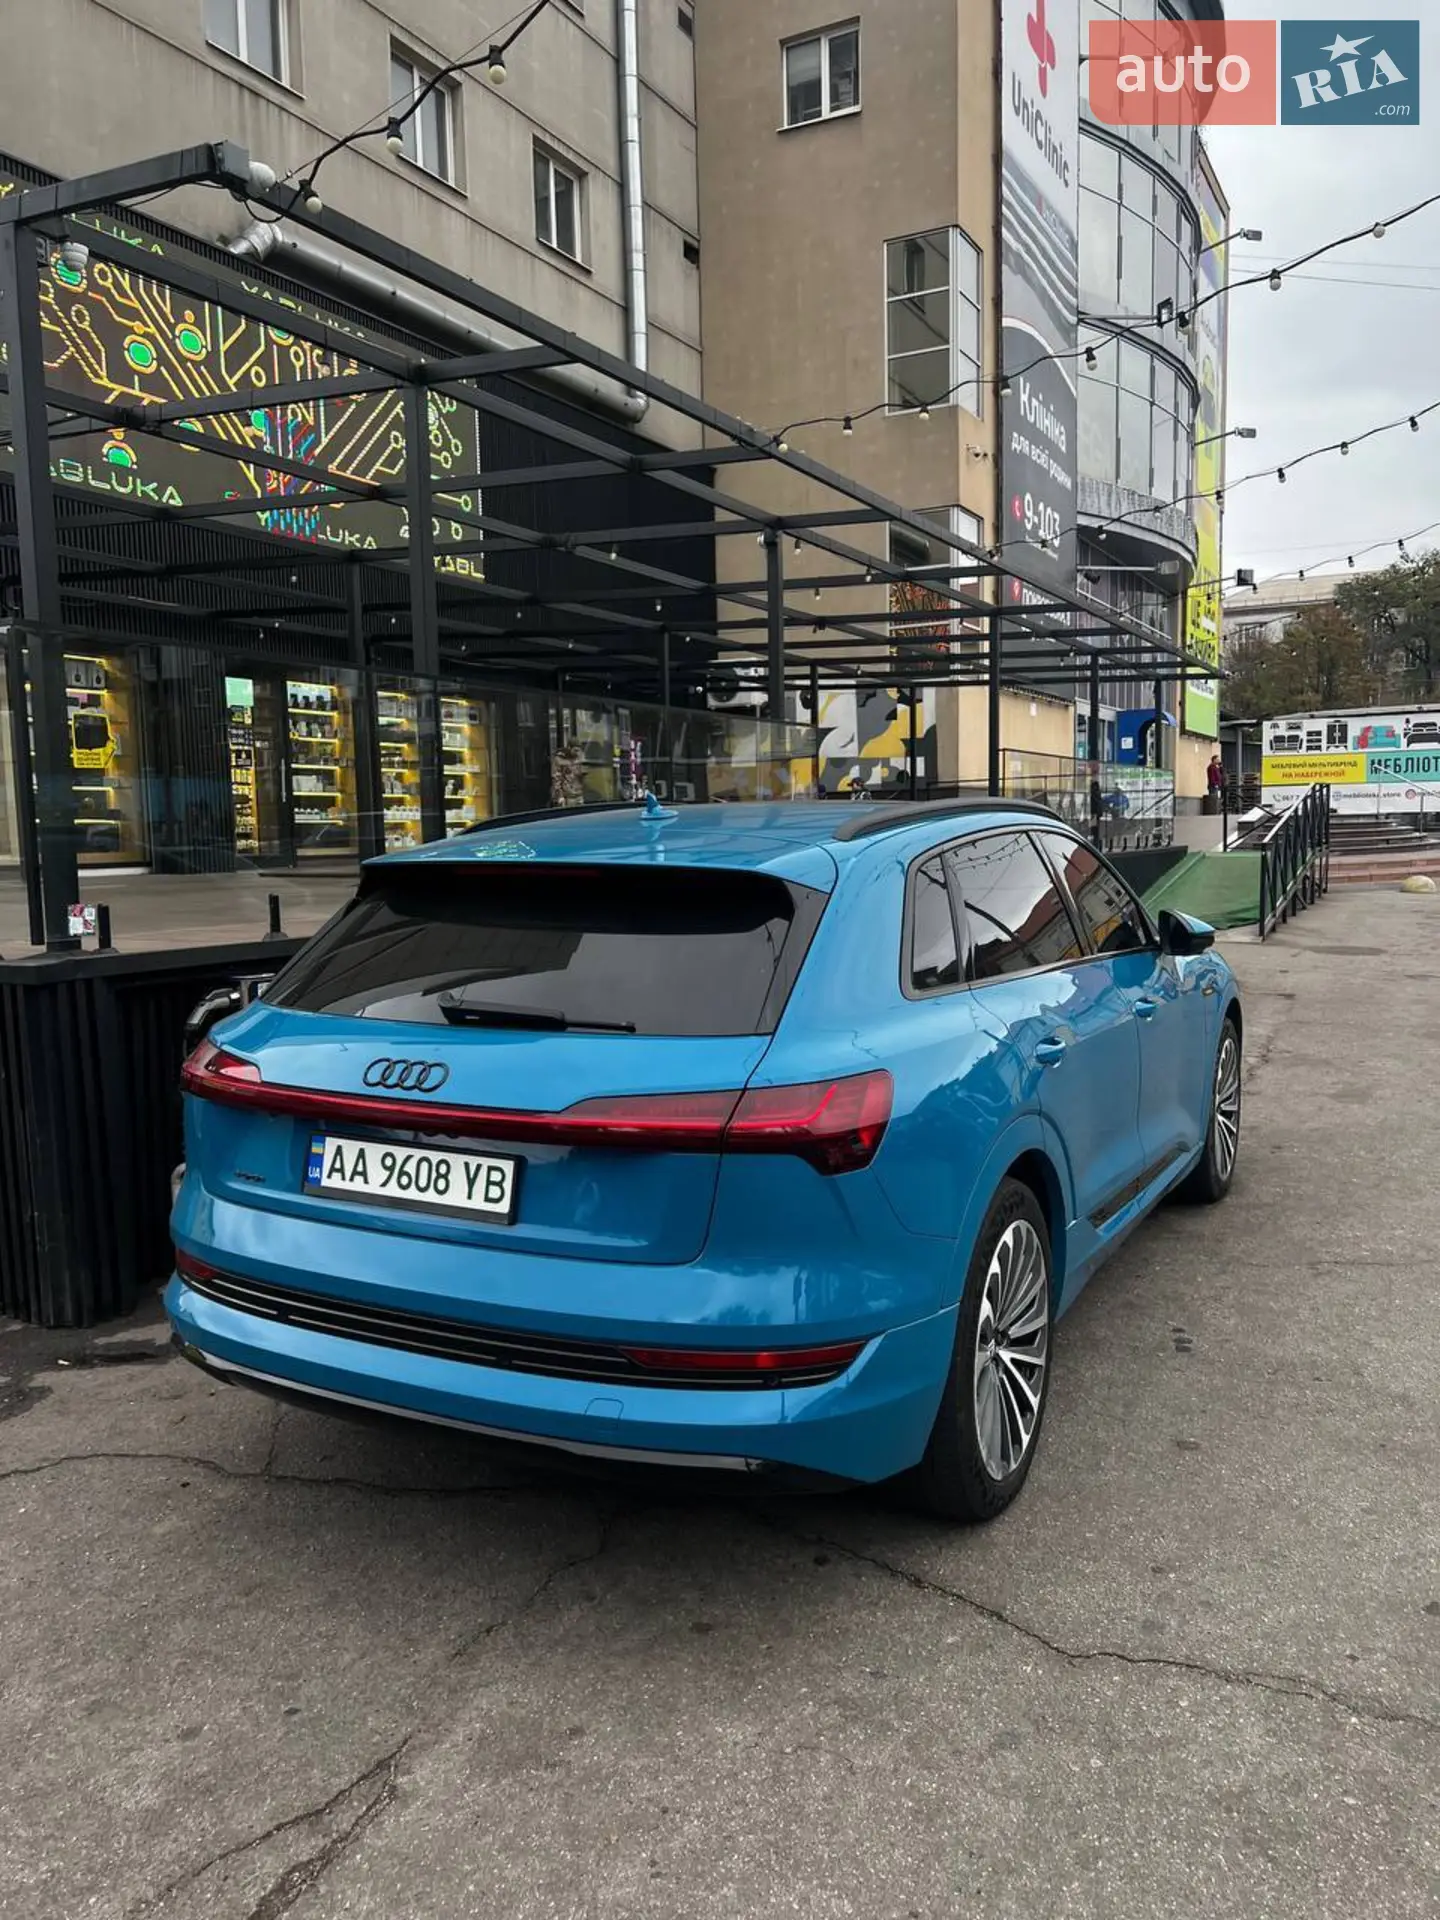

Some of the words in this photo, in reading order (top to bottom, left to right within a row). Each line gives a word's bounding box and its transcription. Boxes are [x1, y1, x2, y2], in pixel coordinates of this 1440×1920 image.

[1012, 72, 1069, 188] UniClinic
[1020, 376, 1067, 454] Клініка
[1024, 492, 1060, 548] 9-103
[308, 1166, 321, 1179] UA
[327, 1144, 369, 1185] AA
[380, 1151, 451, 1195] 9608
[463, 1160, 507, 1204] YB
